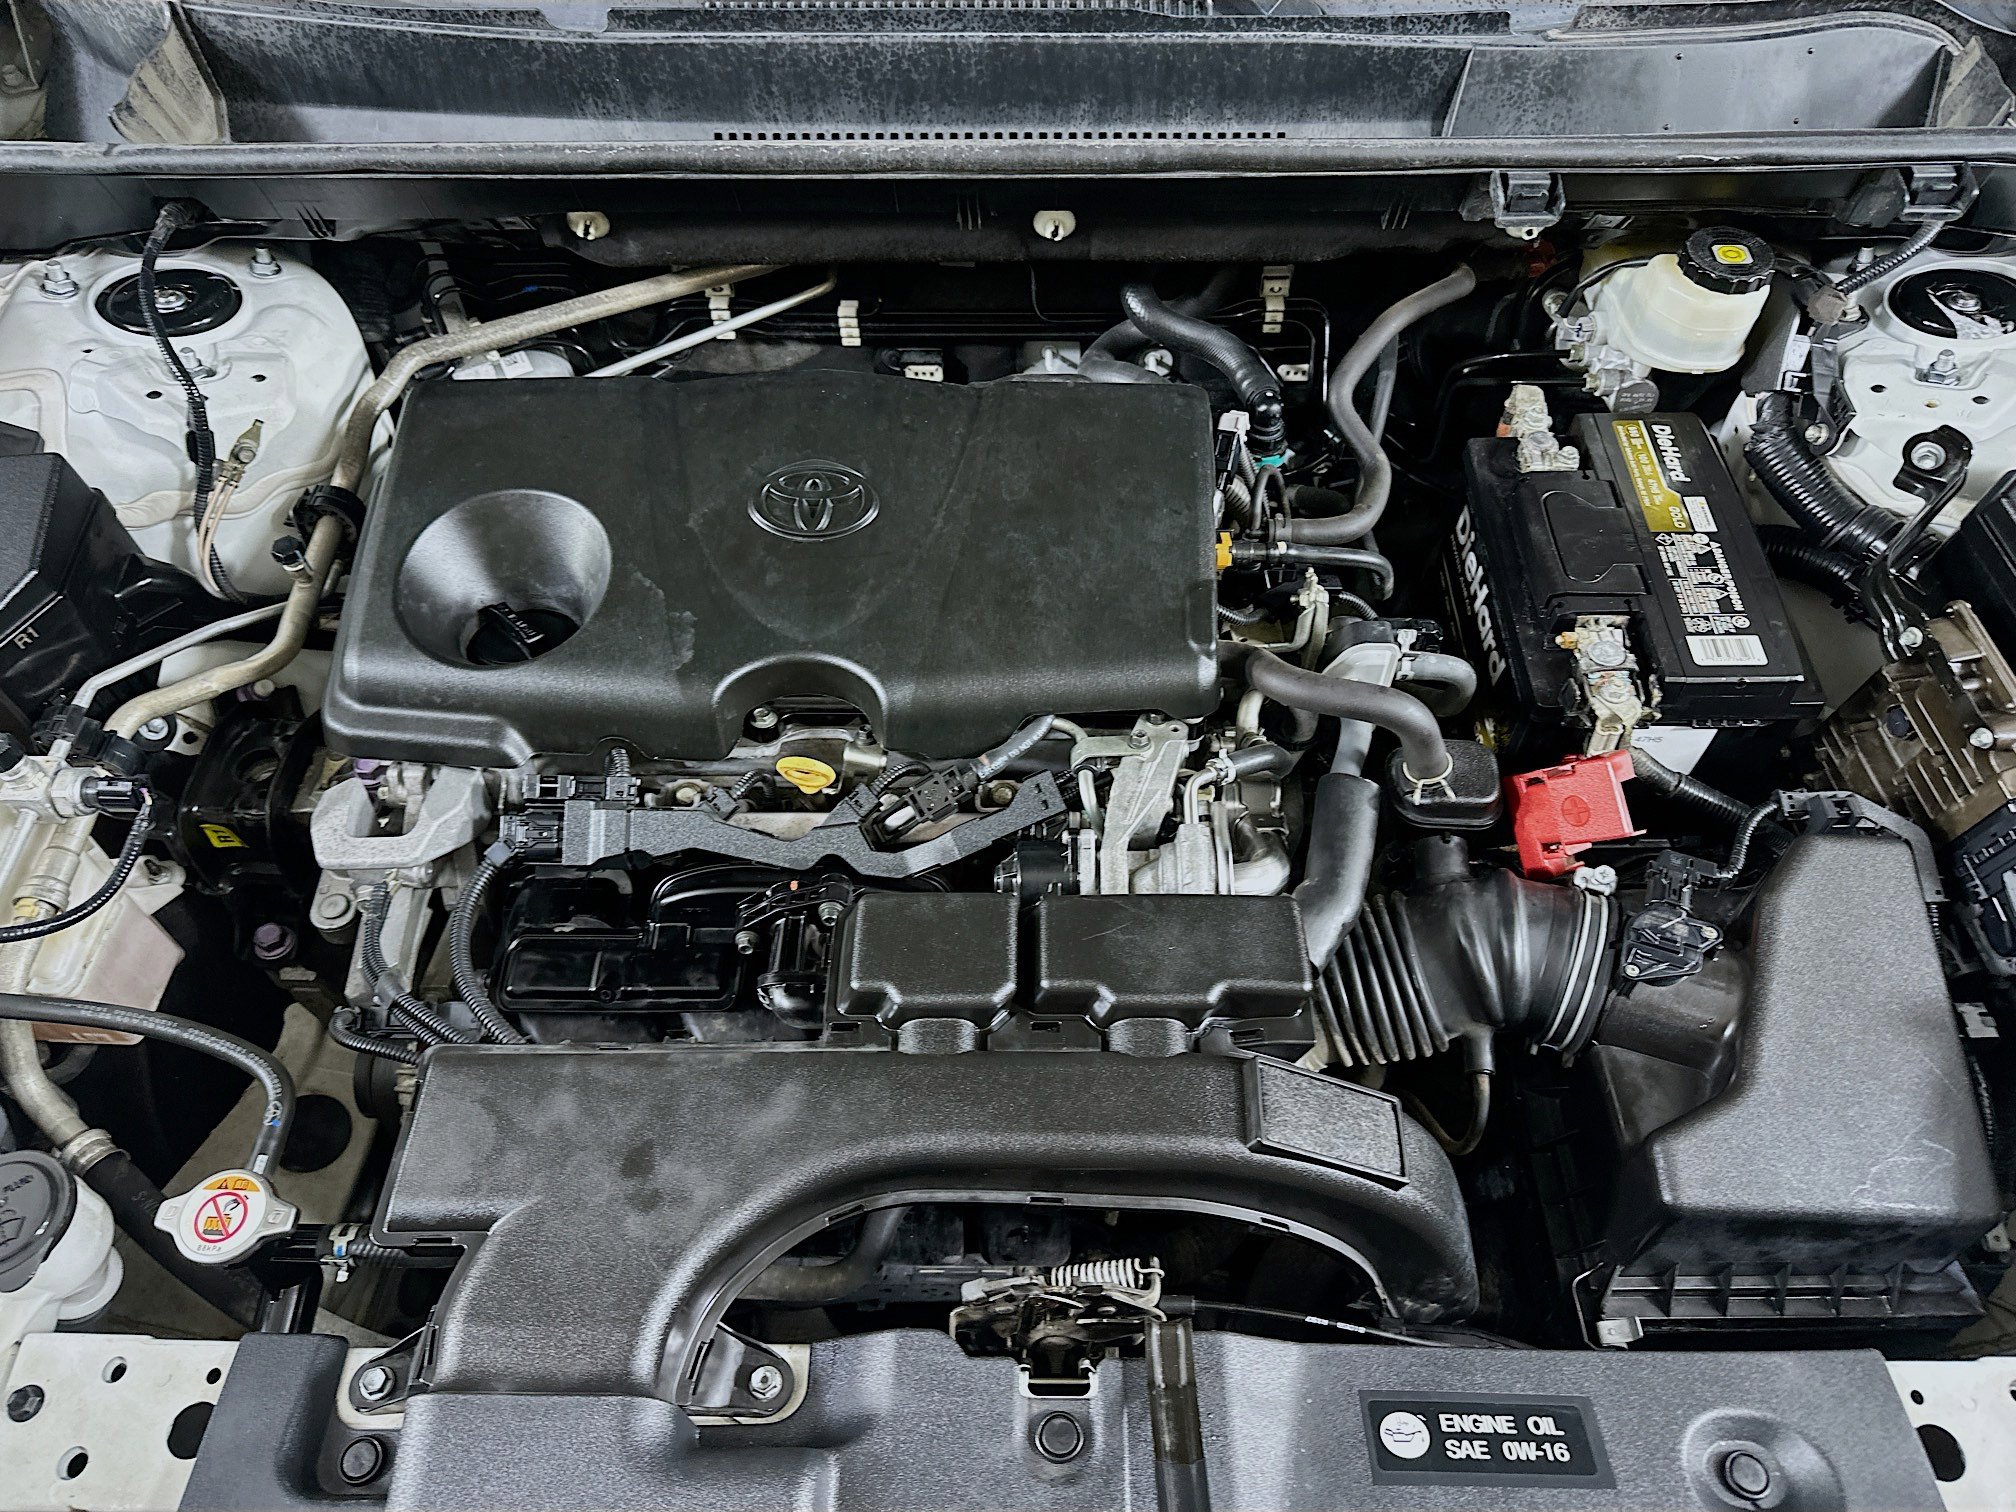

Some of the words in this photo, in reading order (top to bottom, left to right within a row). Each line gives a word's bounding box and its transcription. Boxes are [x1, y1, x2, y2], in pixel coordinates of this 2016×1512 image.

[1651, 424, 1692, 483] DieHard
[1668, 506, 1687, 529] GOLD
[1456, 504, 1506, 687] DieHard
[13, 626, 40, 650] R1
[1438, 1413, 1518, 1434] ENGINE
[1526, 1415, 1565, 1436] OIL
[1444, 1439, 1492, 1460] SAE
[1502, 1441, 1571, 1462] 0W-16
